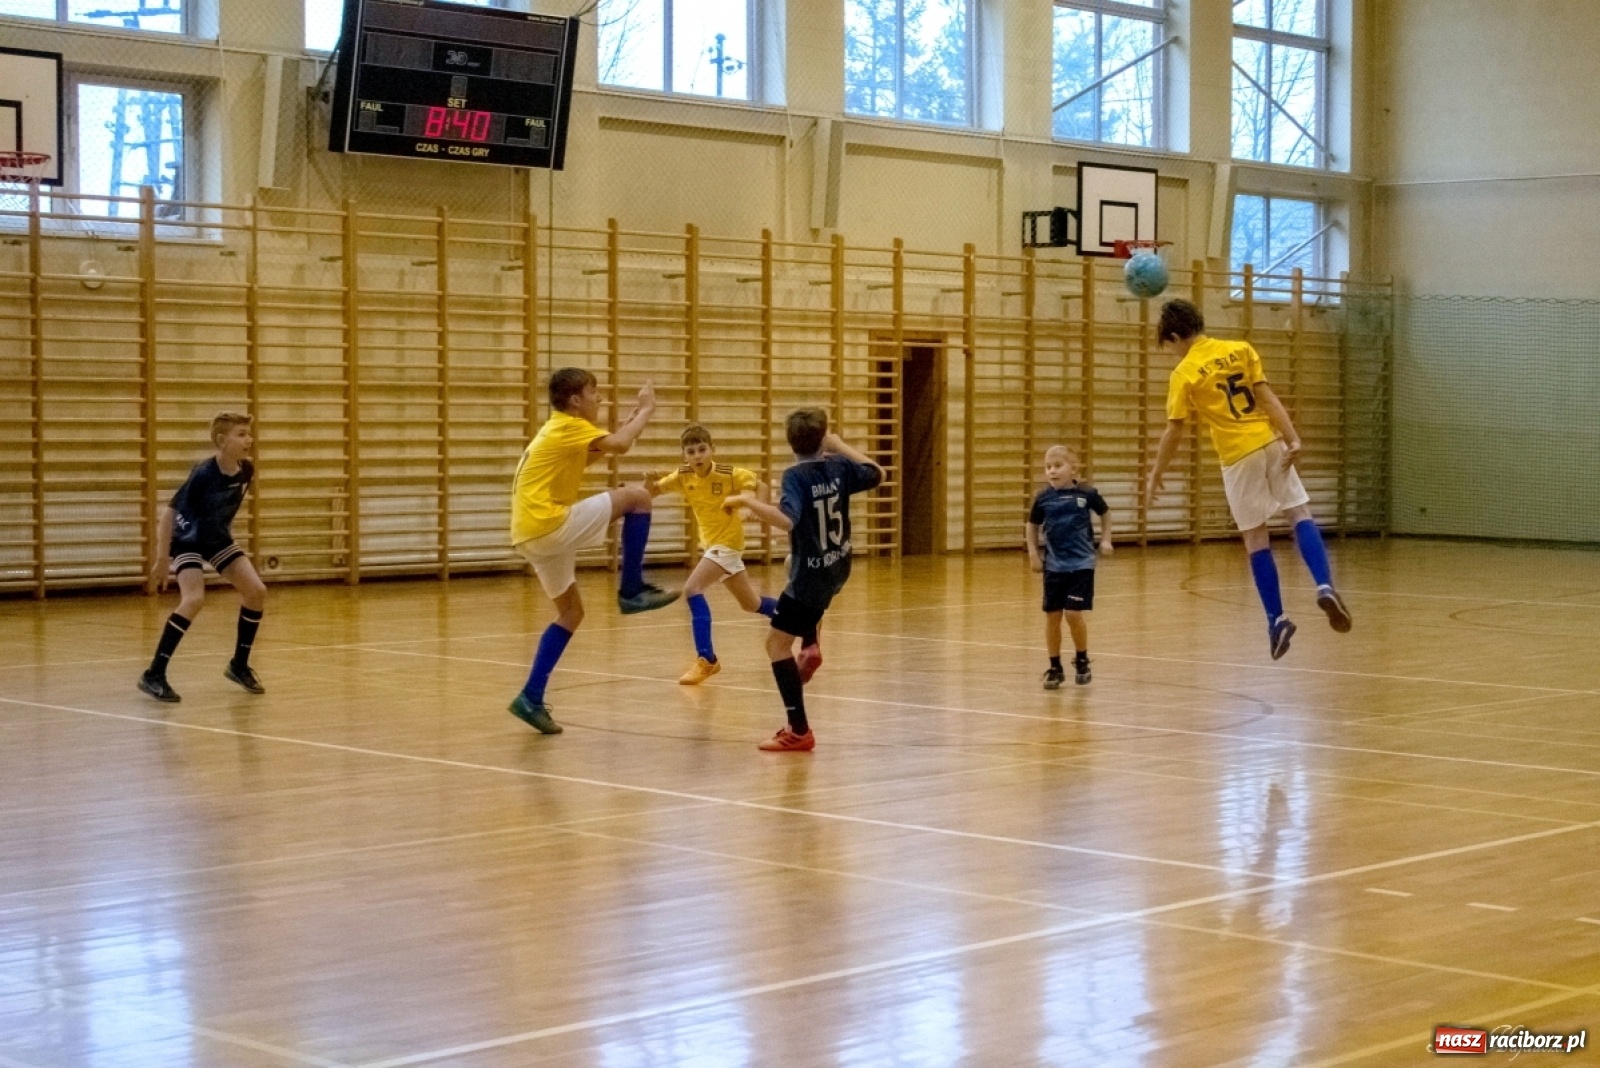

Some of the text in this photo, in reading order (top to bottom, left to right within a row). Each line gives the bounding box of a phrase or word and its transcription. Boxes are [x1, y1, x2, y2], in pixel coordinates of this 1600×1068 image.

[360, 102, 383, 112] FAUL
[447, 98, 467, 108] SET
[425, 107, 490, 141] 8:40
[525, 119, 547, 128] FAUL
[415, 143, 439, 153] CZAS
[448, 147, 470, 156] CZAS
[472, 148, 490, 157] GRY
[1216, 372, 1256, 419] 15
[813, 494, 843, 550] 15
[807, 557, 821, 568] KS
